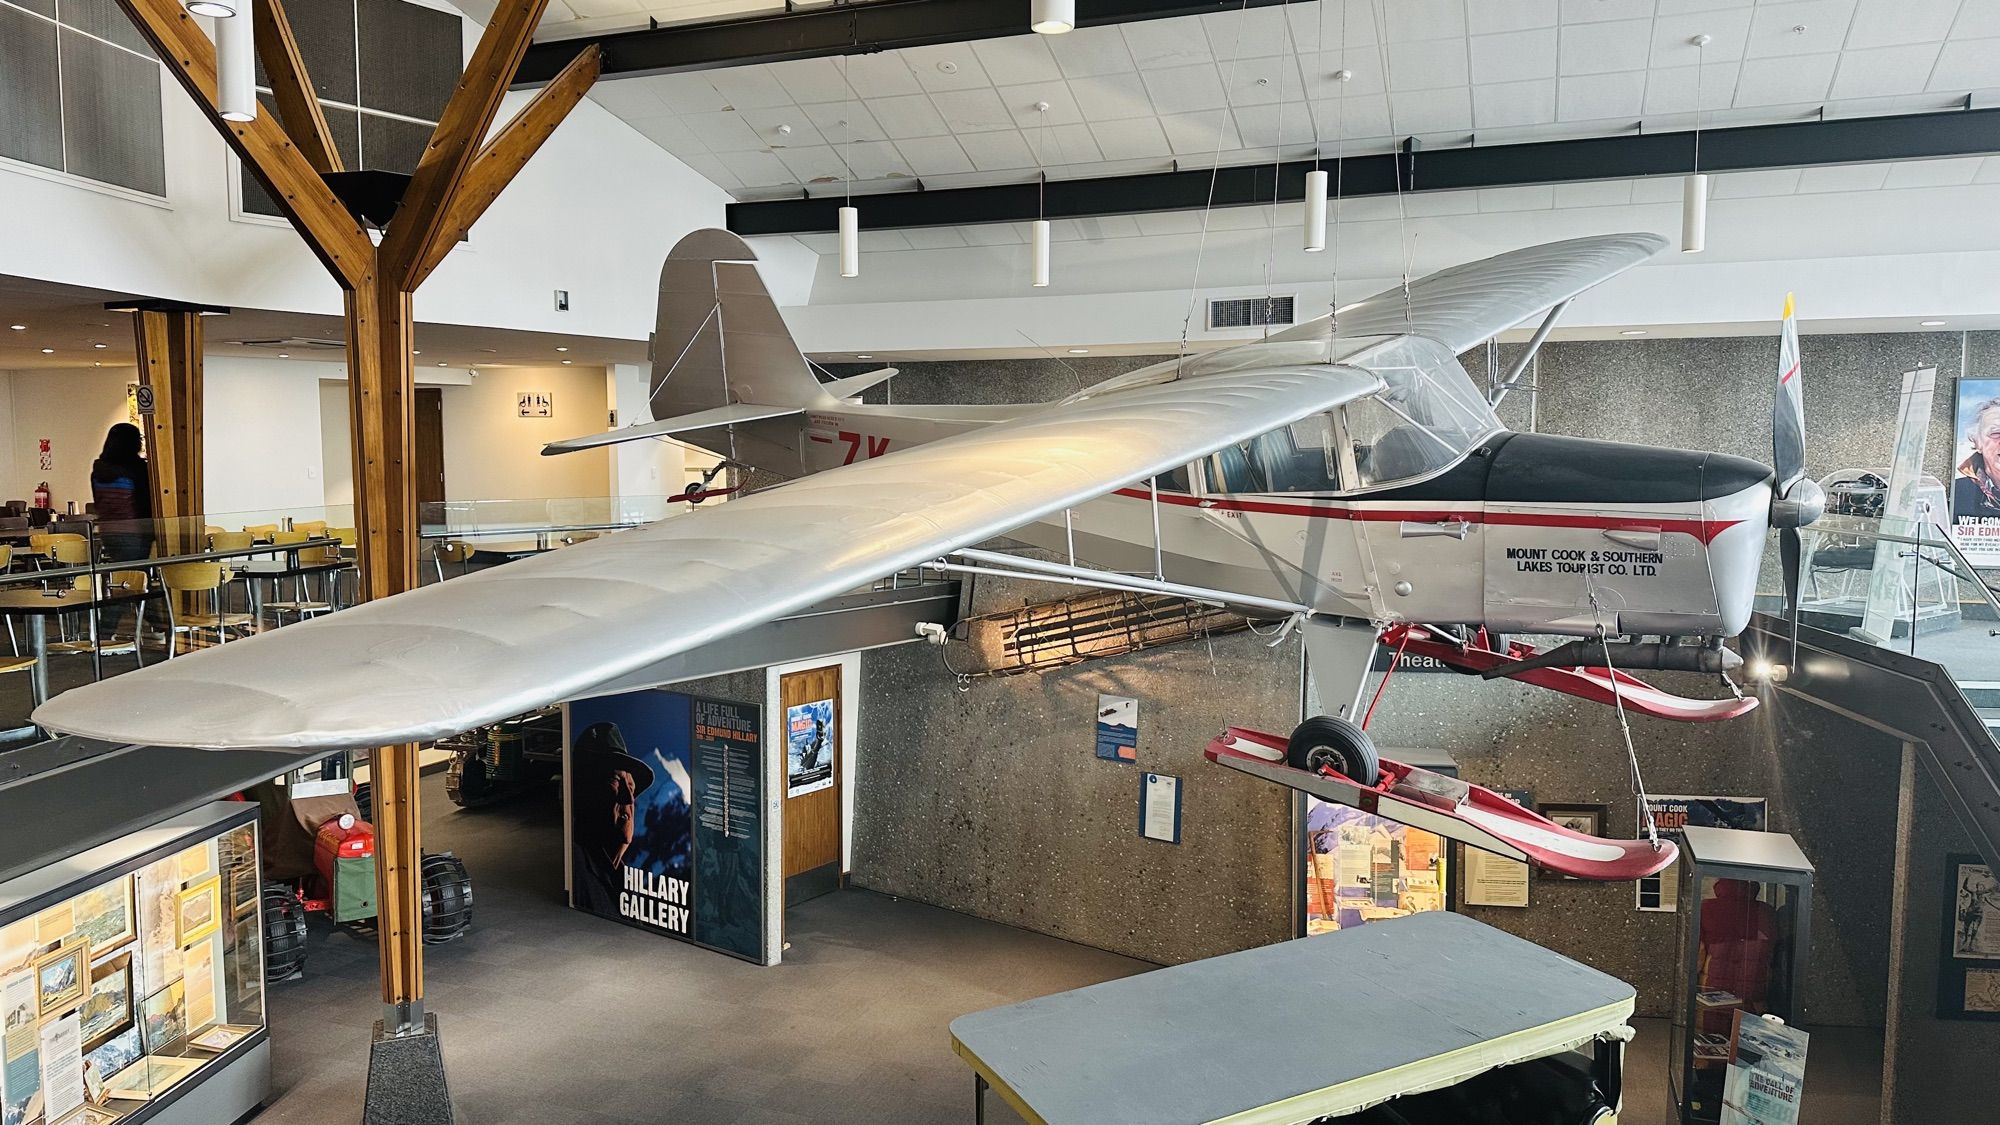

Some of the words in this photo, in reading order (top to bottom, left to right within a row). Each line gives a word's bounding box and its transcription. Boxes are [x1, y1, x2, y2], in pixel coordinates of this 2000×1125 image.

[1958, 526, 1974, 536] SIR
[1979, 528, 2000, 536] EDM
[1507, 548, 1547, 559] MOUNT
[1552, 550, 1585, 561] COOK
[1591, 551, 1600, 561] &
[1603, 551, 1663, 563] SOUTHERN
[1518, 561, 1552, 572] LAKES
[1557, 562, 1605, 574] TOURIST
[1608, 565, 1628, 576] CO.
[1633, 565, 1656, 576] LTD.
[1388, 652, 1446, 668] Theat
[696, 701, 701, 712] A
[703, 702, 719, 716] LIFE
[721, 705, 739, 718] FULL
[696, 713, 705, 724] OF
[708, 715, 752, 732] ADVENTURE
[696, 725, 705, 734] SIR
[707, 727, 731, 738] EDMUND
[733, 731, 757, 743] HILLARY
[1646, 804, 1667, 812] OUNT
[624, 865, 689, 906] HILLARY
[620, 892, 689, 933] GALLERY
[1750, 1080, 1794, 1103] ADVENTURE
[1766, 1079, 1782, 1090] CALL
[1786, 1086, 1795, 1094] OF
